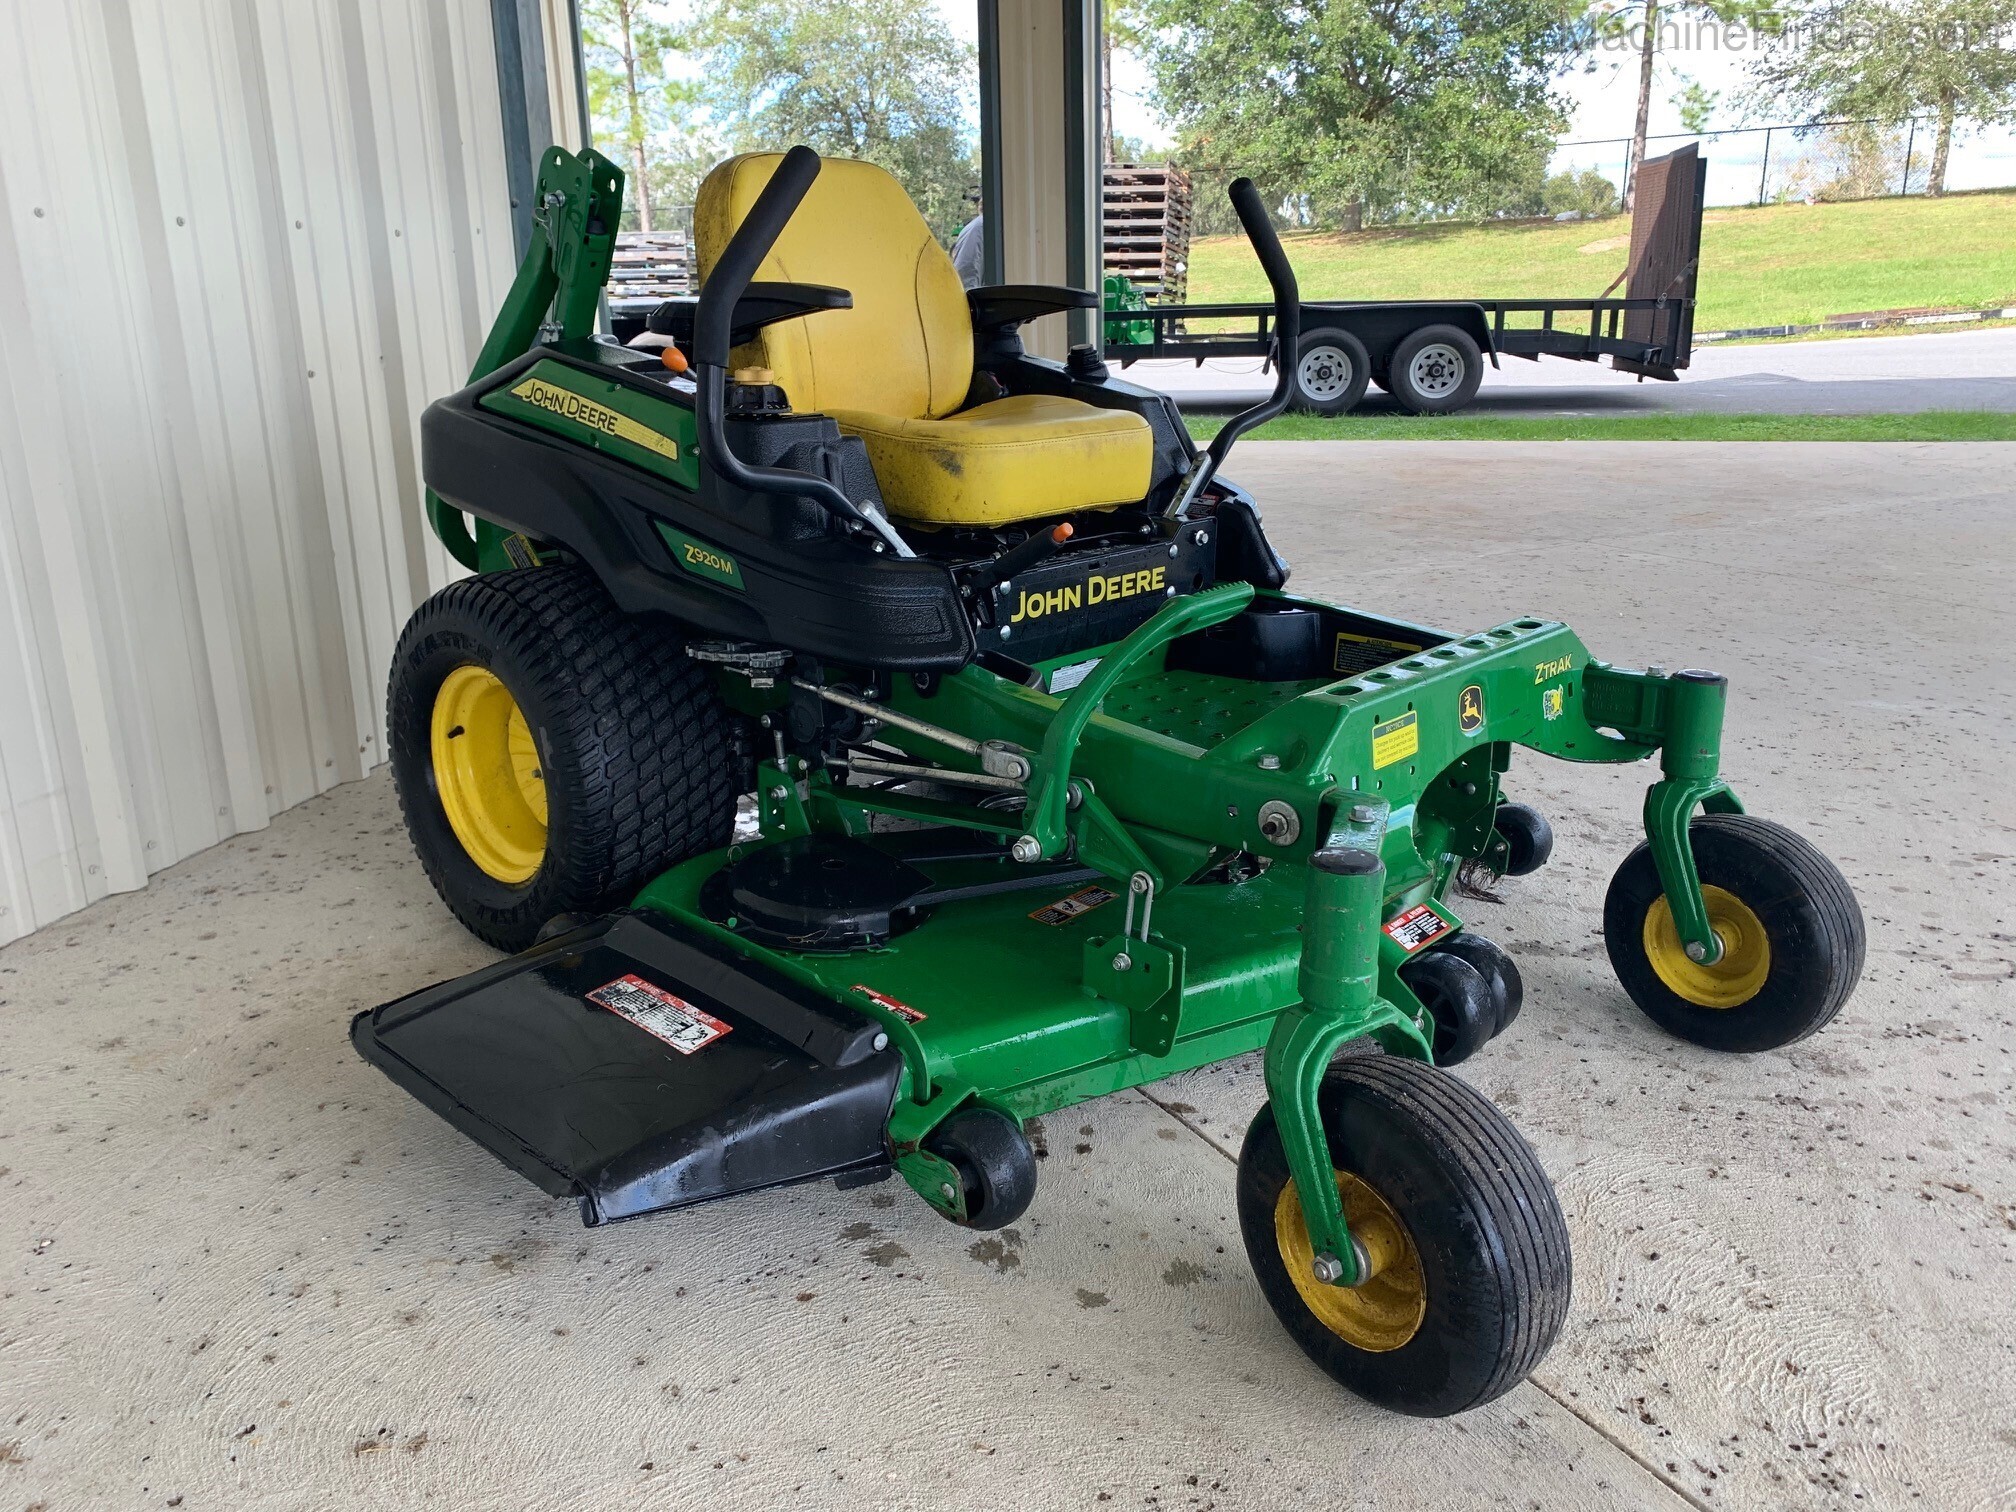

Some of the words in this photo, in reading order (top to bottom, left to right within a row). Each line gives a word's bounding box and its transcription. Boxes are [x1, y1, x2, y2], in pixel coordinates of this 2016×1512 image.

[523, 381, 564, 412] JOHN
[566, 399, 618, 433] DEERE
[684, 543, 733, 575] Z920M
[1011, 585, 1081, 623] JOHN
[1088, 566, 1166, 605] DEERE
[1534, 654, 1573, 685] ZTRAK
